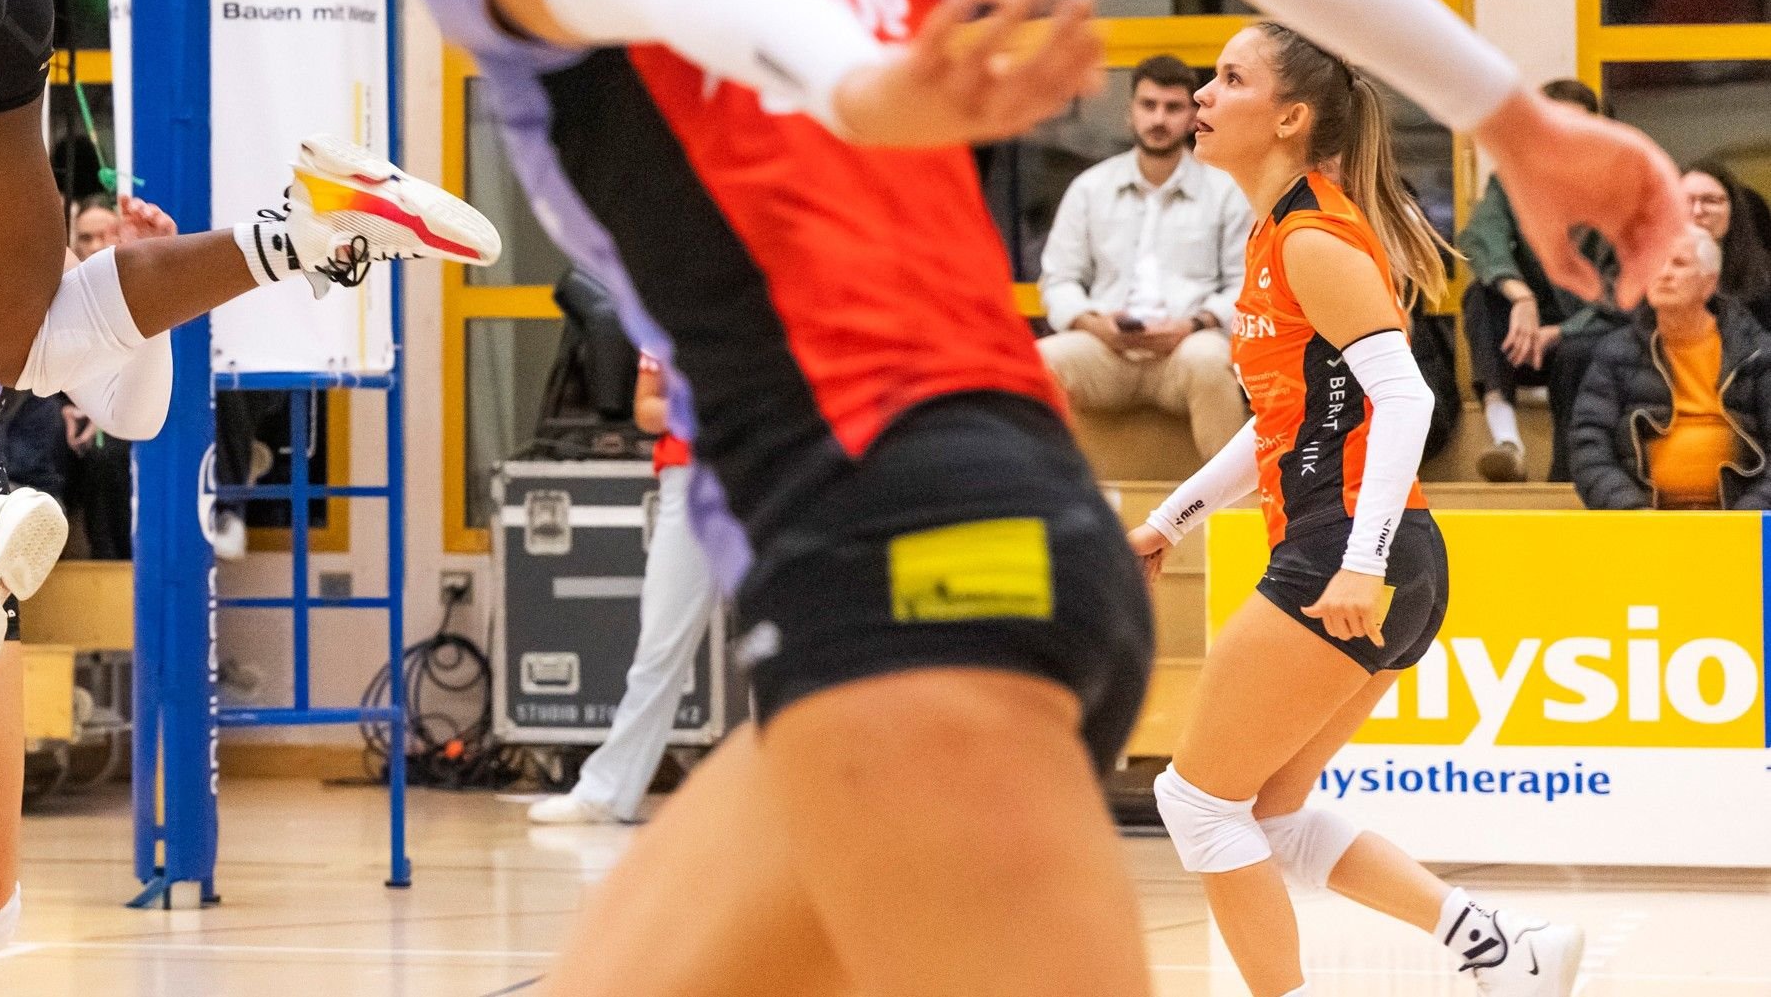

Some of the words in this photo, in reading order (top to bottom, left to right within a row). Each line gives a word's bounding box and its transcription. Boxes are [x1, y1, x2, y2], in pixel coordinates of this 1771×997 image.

[223, 2, 302, 21] Bauen
[1179, 498, 1205, 521] nine
[1375, 526, 1391, 558] nine
[1319, 760, 1611, 803] ysiotherapie
